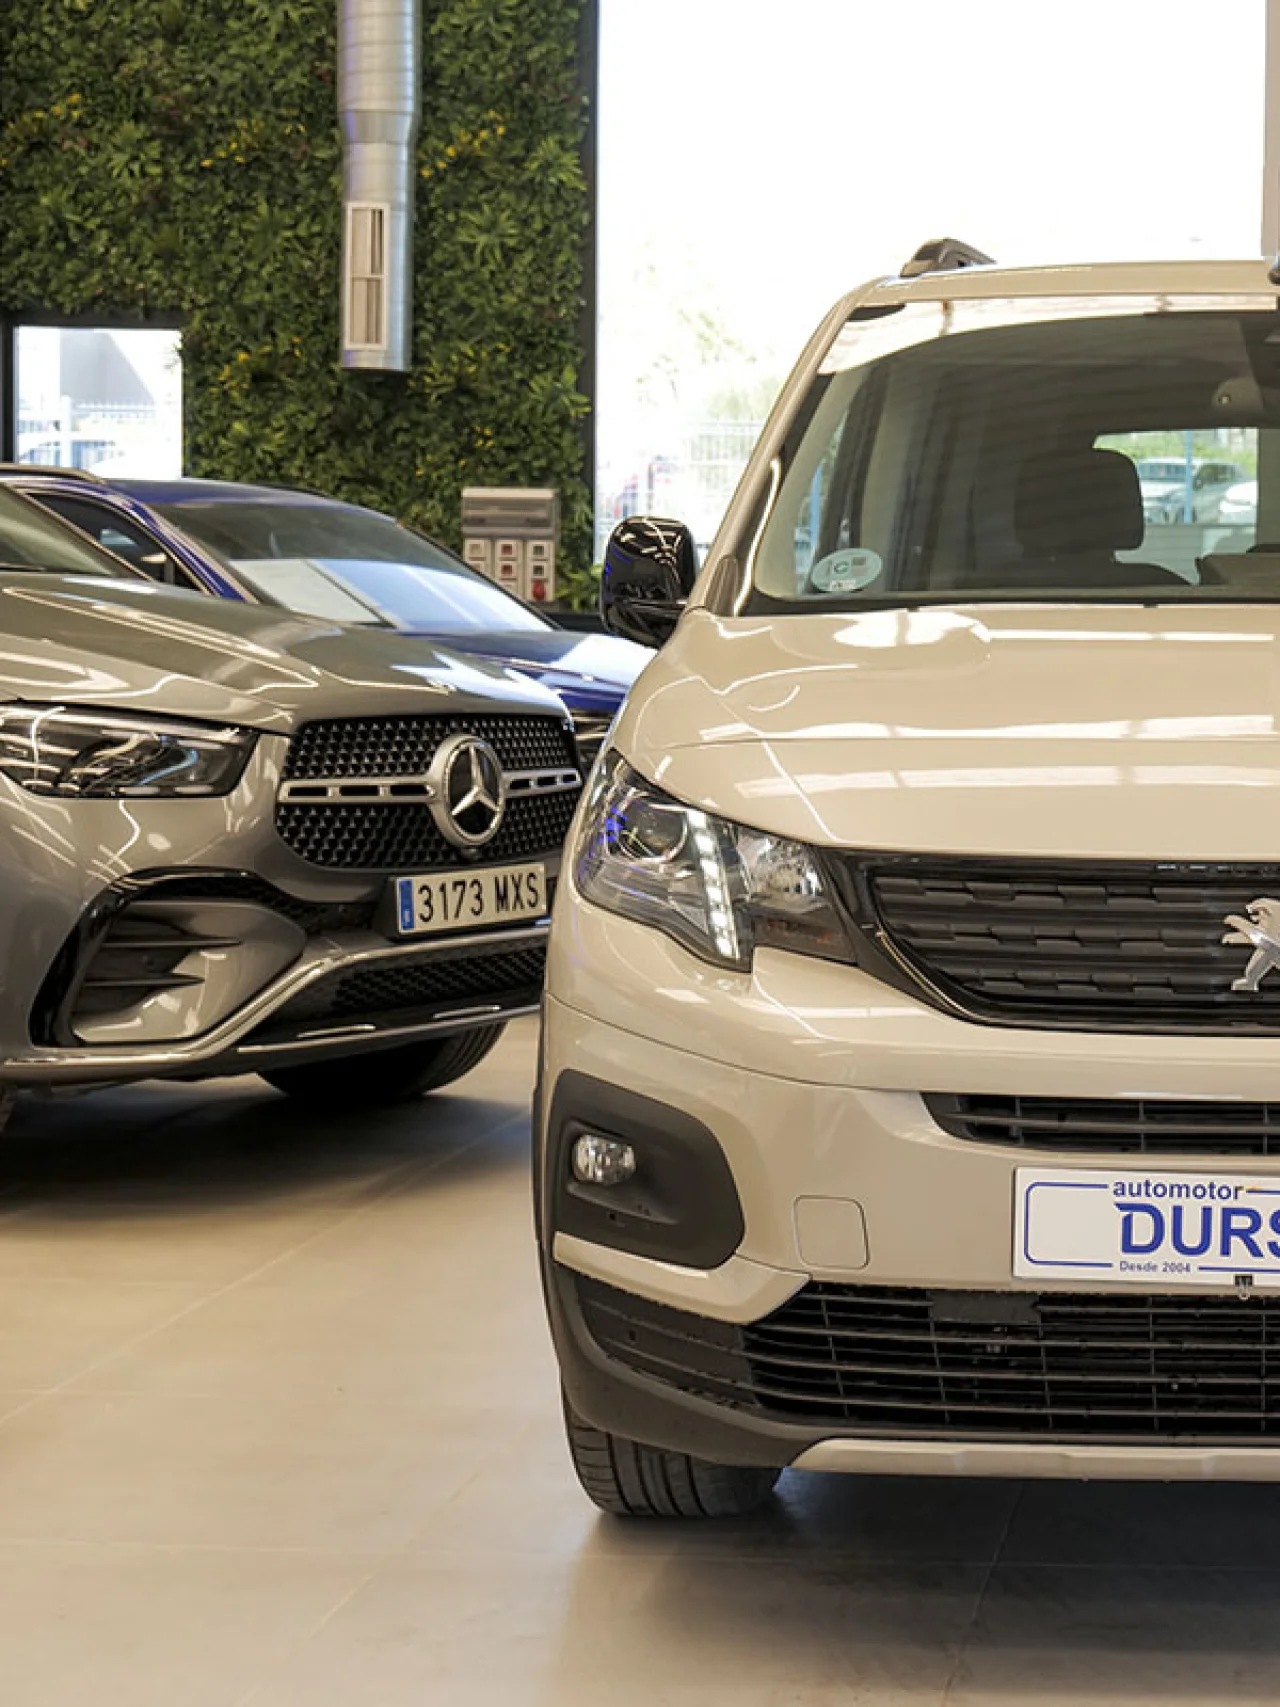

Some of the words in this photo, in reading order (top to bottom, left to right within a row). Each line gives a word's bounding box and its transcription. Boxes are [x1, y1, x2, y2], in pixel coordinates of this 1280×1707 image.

[417, 879, 484, 923] 3173
[494, 872, 540, 914] MXS
[1112, 1180, 1245, 1202] automotor
[1119, 1260, 1158, 1273] Desde
[1162, 1261, 1191, 1273] 2004
